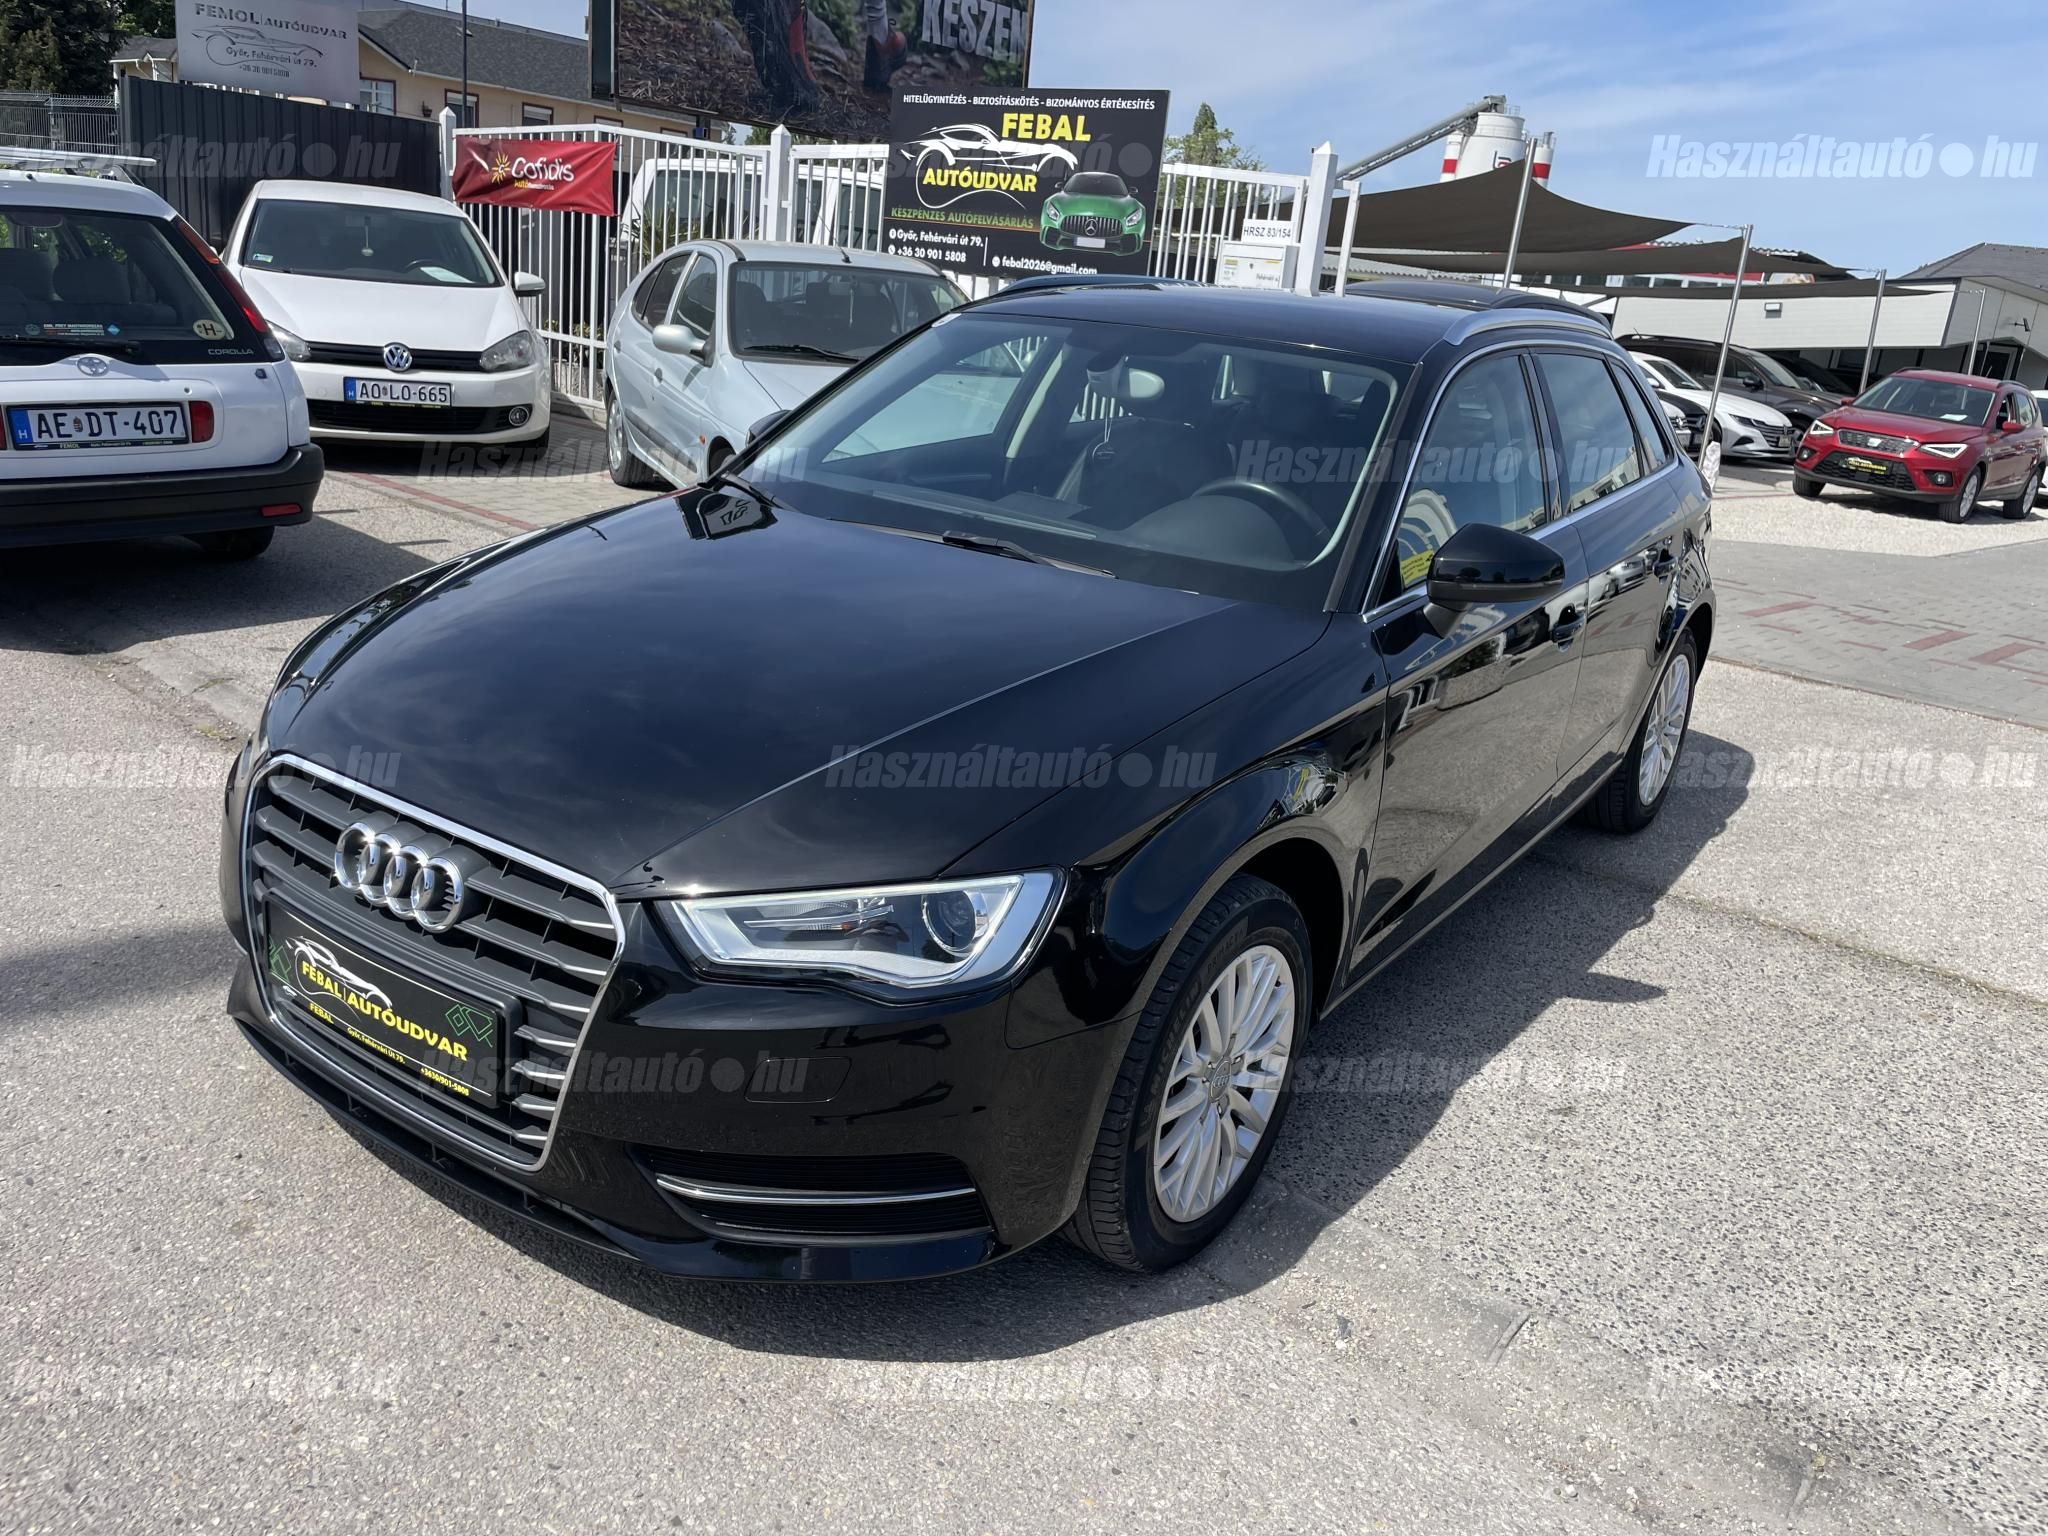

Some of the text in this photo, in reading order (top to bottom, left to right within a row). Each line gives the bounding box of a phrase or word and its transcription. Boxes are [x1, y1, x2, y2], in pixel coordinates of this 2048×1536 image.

[195, 3, 347, 39] FEMOL AUTÓUDVAR
[903, 93, 967, 105] HITELÜGYINTÉZÉS
[973, 95, 1039, 107] BIZTOSÍTÁSKÖTÉS
[1046, 96, 1099, 109] BIZOMÁNYOS
[1101, 97, 1155, 110] ÉRTÉKESÍTÉS
[1002, 112, 1092, 142] FEBAL
[512, 157, 575, 182] Cofidis
[922, 166, 1037, 192] AUTÓUDVAR
[920, 231, 959, 245] Fehérvári
[959, 233, 969, 246] út
[970, 236, 984, 247] 79.
[1243, 226, 1266, 237] HRSZ
[897, 247, 967, 262] +36 30 901 5808
[1002, 255, 1097, 275] febal2026@gmail.com
[208, 348, 254, 356] COROLLA
[302, 960, 468, 1062] FEBAL AUTÓUDVAR
[309, 1002, 335, 1024] FEBAL
